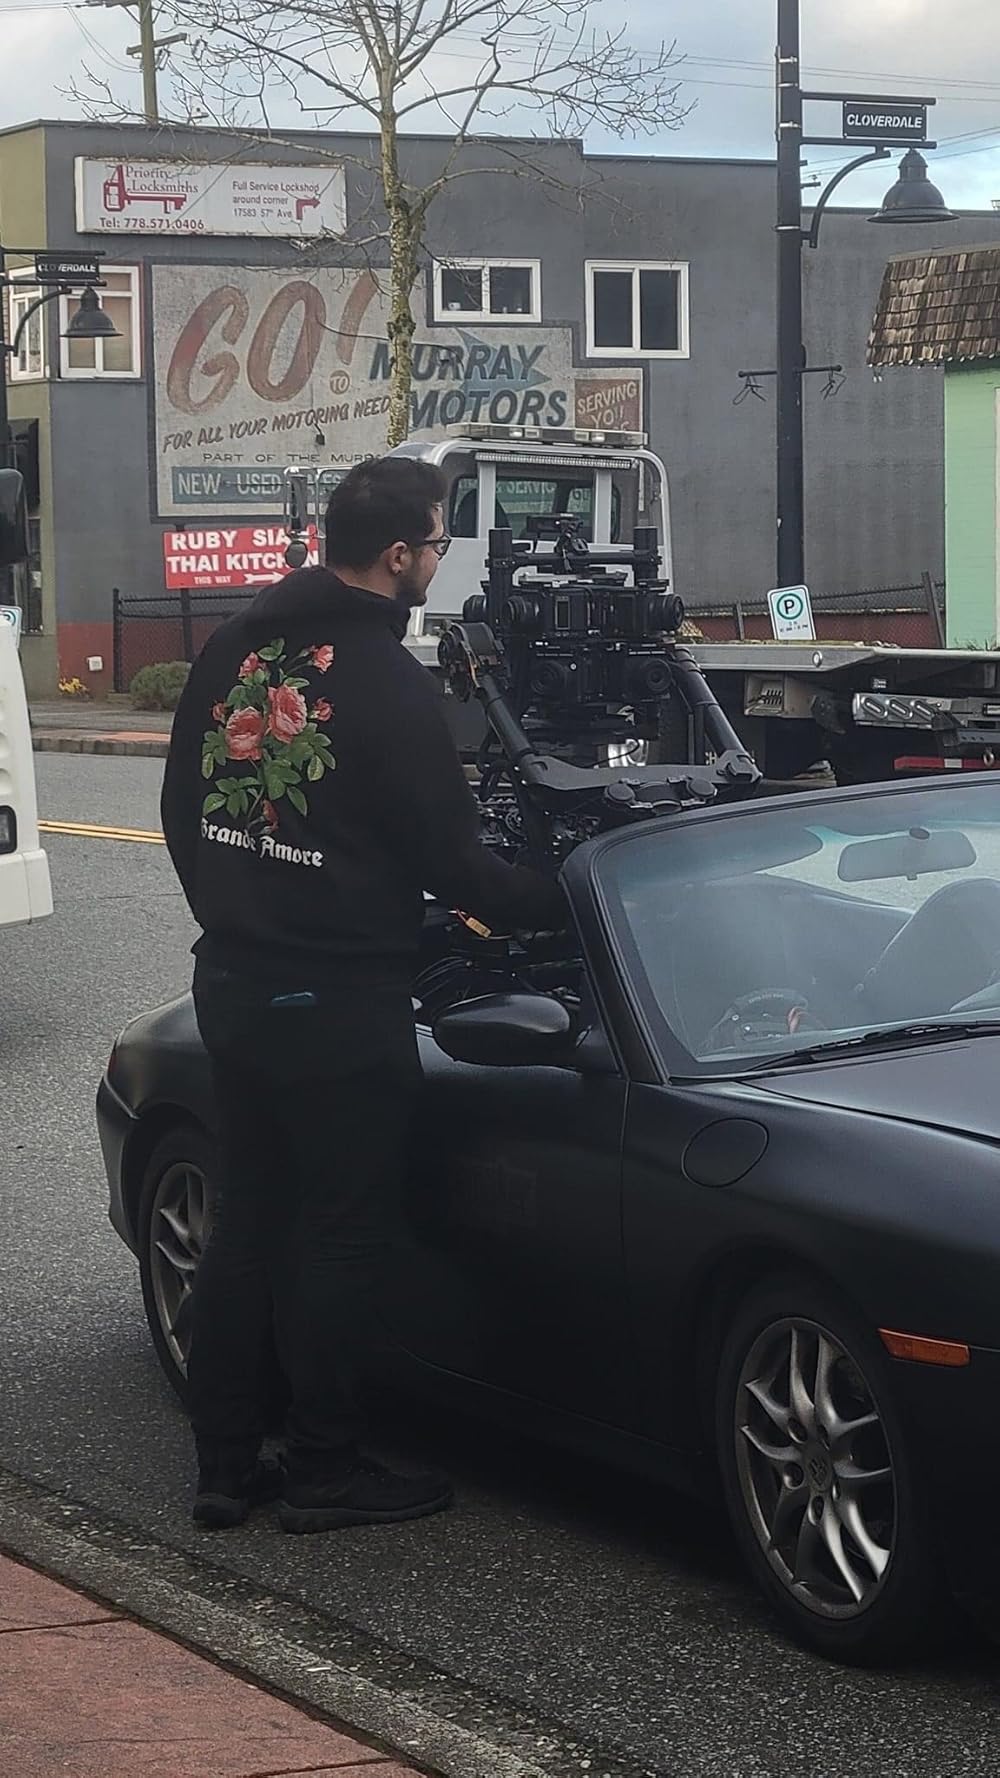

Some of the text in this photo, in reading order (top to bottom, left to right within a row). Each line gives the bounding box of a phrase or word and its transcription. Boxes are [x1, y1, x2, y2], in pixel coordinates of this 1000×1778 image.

[846, 114, 922, 128] CLOVERDALE
[126, 166, 173, 180] Priority
[131, 180, 198, 193] Locksmiths
[232, 181, 319, 193] Full Service Lockshop
[233, 195, 288, 205] around corner
[277, 209, 293, 218] Ave
[100, 218, 204, 229] Tel: 778.571.0406
[38, 263, 96, 272] CLOVERDALE
[369, 343, 546, 381] MURRAY
[577, 381, 636, 415] SERVING
[409, 389, 567, 428] MOTORS
[163, 395, 391, 453] FOR ALL YOUR MOTORING NEED
[203, 453, 244, 463] PART
[255, 453, 276, 463] OF
[287, 453, 320, 463] THE
[178, 473, 221, 496] NEW
[236, 474, 282, 496] USED
[172, 528, 309, 551] RUBY SIA
[166, 550, 319, 574] THAI KITCHN
[194, 575, 232, 585] THIS WAY
[260, 835, 323, 867] Amore
